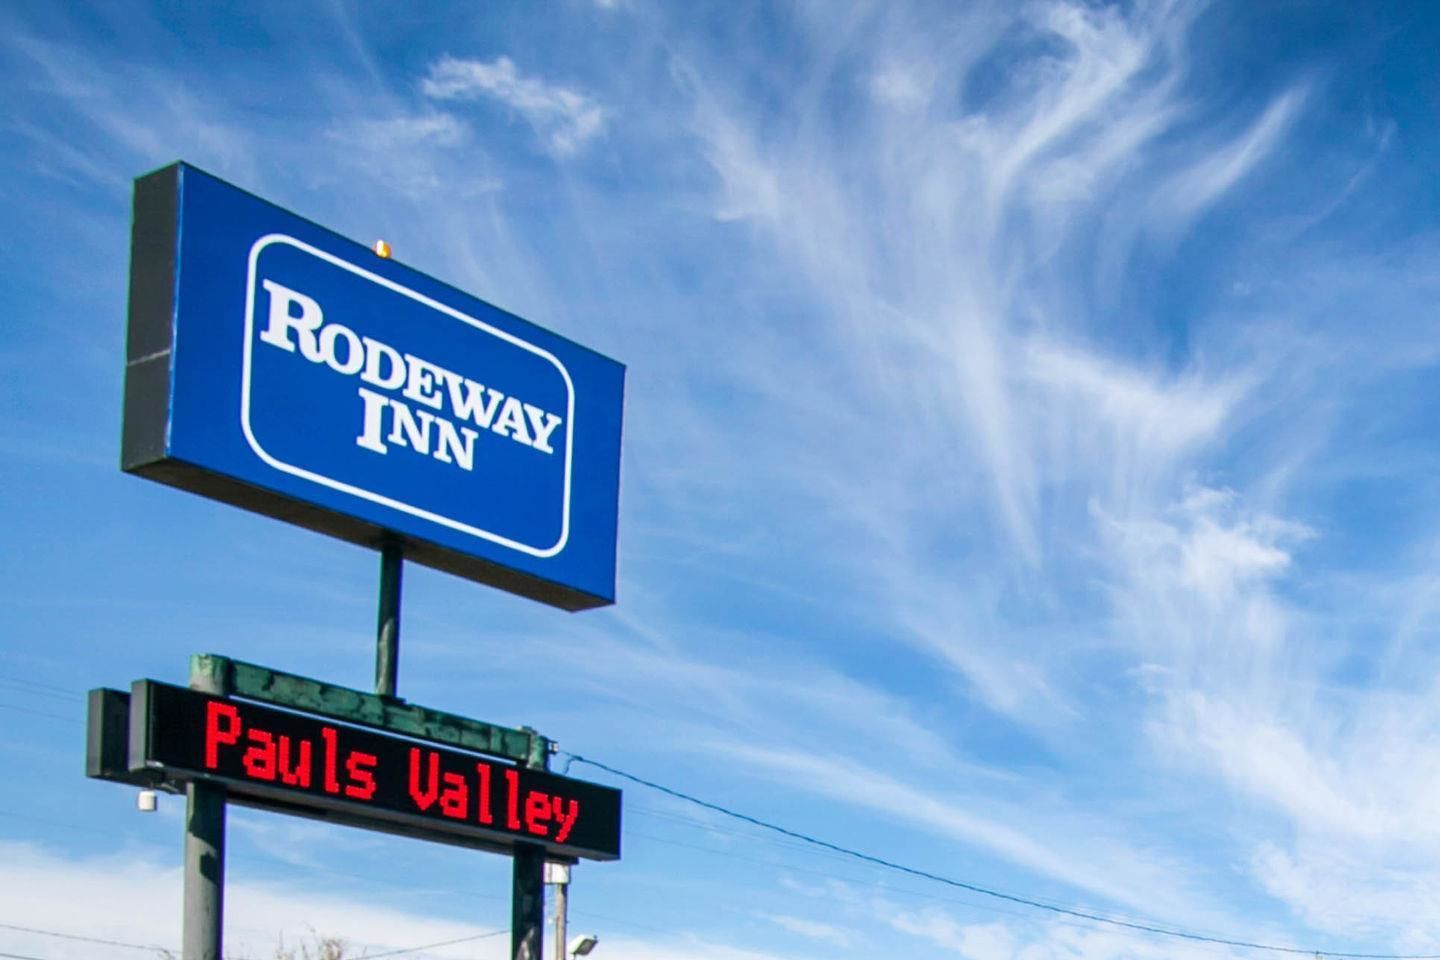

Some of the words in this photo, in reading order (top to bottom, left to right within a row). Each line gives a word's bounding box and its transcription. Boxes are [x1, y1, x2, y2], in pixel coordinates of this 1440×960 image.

[260, 279, 562, 454] RODEWAY
[356, 387, 479, 471] INN
[206, 701, 378, 800] Pauls
[409, 747, 579, 843] Valley
